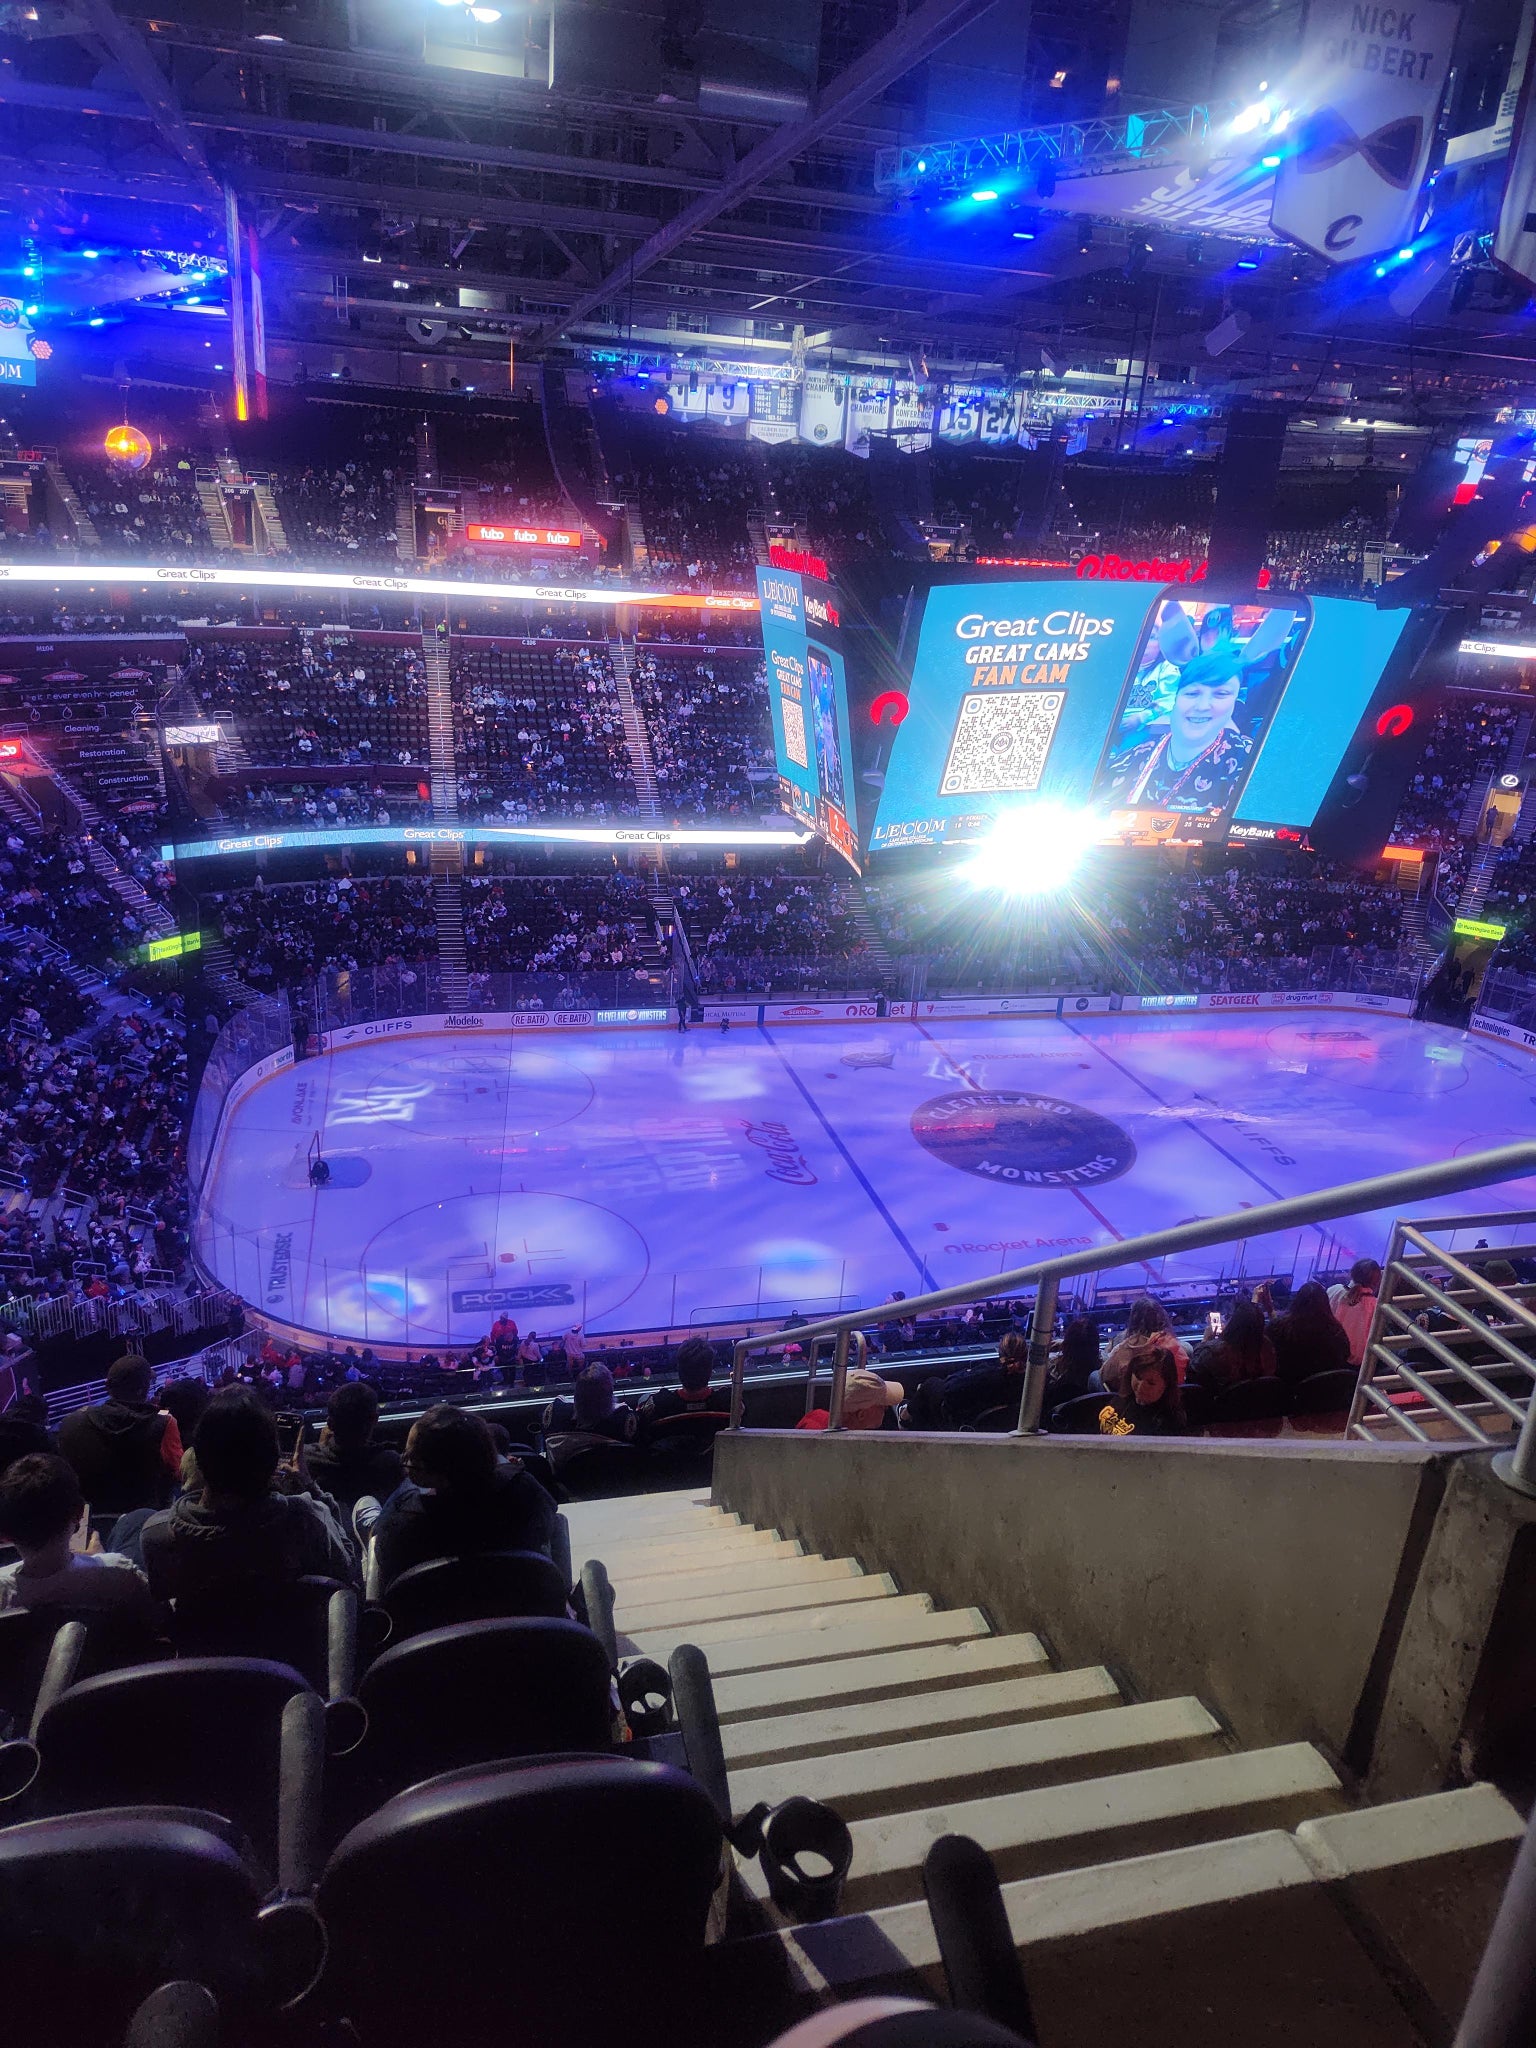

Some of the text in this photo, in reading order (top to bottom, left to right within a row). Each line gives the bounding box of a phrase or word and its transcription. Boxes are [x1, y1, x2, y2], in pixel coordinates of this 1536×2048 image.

[1350, 3, 1419, 42] NICK
[1322, 38, 1434, 81] GILBERT
[722, 384, 735, 411] 9
[480, 527, 505, 540] fubo
[513, 529, 538, 542] fubo
[546, 532, 570, 544] fubo
[157, 568, 217, 581] Great Clips
[1099, 554, 1192, 583] Rocket
[352, 576, 408, 590] Great Clips
[535, 587, 587, 600] Great Clips
[705, 595, 754, 610] Great Clips
[955, 610, 1116, 642] Great Clips
[964, 641, 1091, 666] GREAT CAMS
[1474, 642, 1496, 653] Clips
[971, 662, 1070, 687] FAN CAM
[64, 725, 100, 734] Cleaning
[79, 748, 126, 758] Restoration
[98, 774, 149, 786] Construction
[403, 828, 464, 842] Great Clips
[615, 829, 671, 842] Great Clips
[1228, 824, 1276, 839] KeyBank
[219, 835, 283, 851] Great Clips
[1209, 993, 1260, 1007] SEATGEEK
[1285, 993, 1301, 1002] drug
[364, 1020, 413, 1035] CLIFFS
[448, 1015, 479, 1026] Modelo
[1472, 1017, 1511, 1037] Technologies
[928, 1094, 1073, 1121] CLEVELAND
[975, 1153, 1118, 1184] MONSTERS
[960, 1233, 1093, 1254] Rocket Arena
[267, 1231, 294, 1292] TRUSTEDSEC
